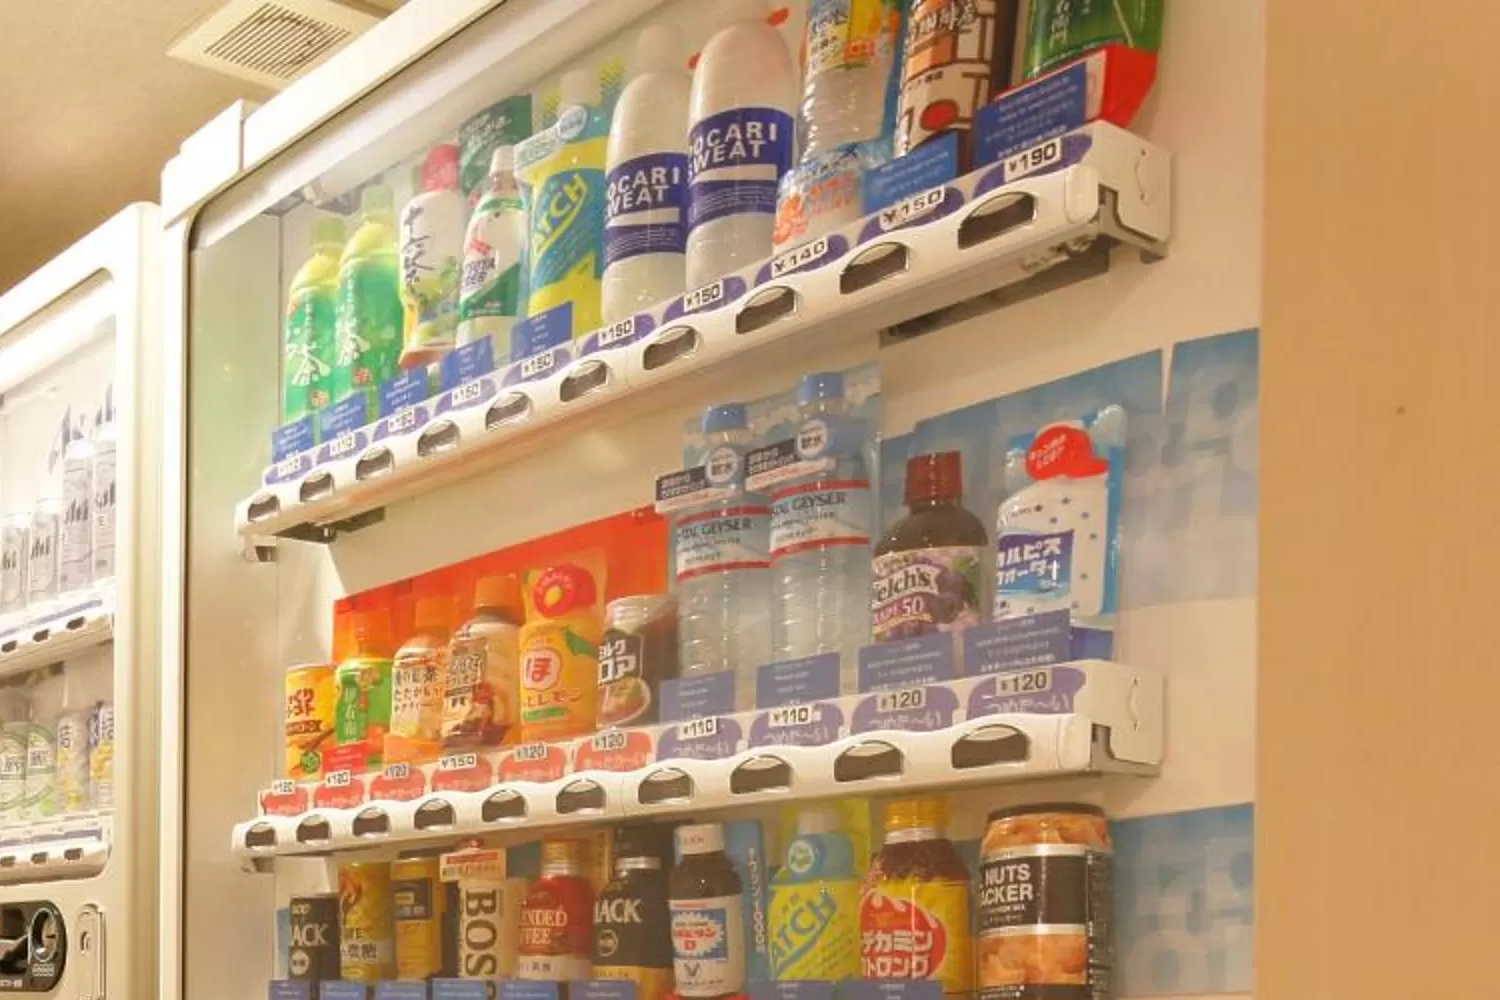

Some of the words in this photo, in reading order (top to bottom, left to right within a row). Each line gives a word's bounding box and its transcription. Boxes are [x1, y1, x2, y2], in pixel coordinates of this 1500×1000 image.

[691, 121, 777, 155] OCARI
[691, 140, 766, 173] WEAT
[1008, 143, 1057, 173] ¥190
[607, 165, 680, 198] OCARI
[607, 185, 669, 218] WEAT
[883, 190, 942, 223] ¥150
[774, 240, 825, 272] ¥140
[686, 284, 721, 306] ¥150
[901, 597, 925, 616] 50
[1001, 672, 1048, 692] ¥120
[881, 690, 922, 709] ¥120
[683, 718, 714, 737] ¥110
[773, 707, 809, 724] ¥110
[594, 734, 624, 749] ¥120
[442, 755, 475, 769] ¥150
[985, 863, 1031, 887] NUTS
[594, 898, 643, 924] LACK
[291, 923, 330, 947] ACK
[771, 889, 837, 962] ATCH
[862, 929, 933, 953] デカミン
